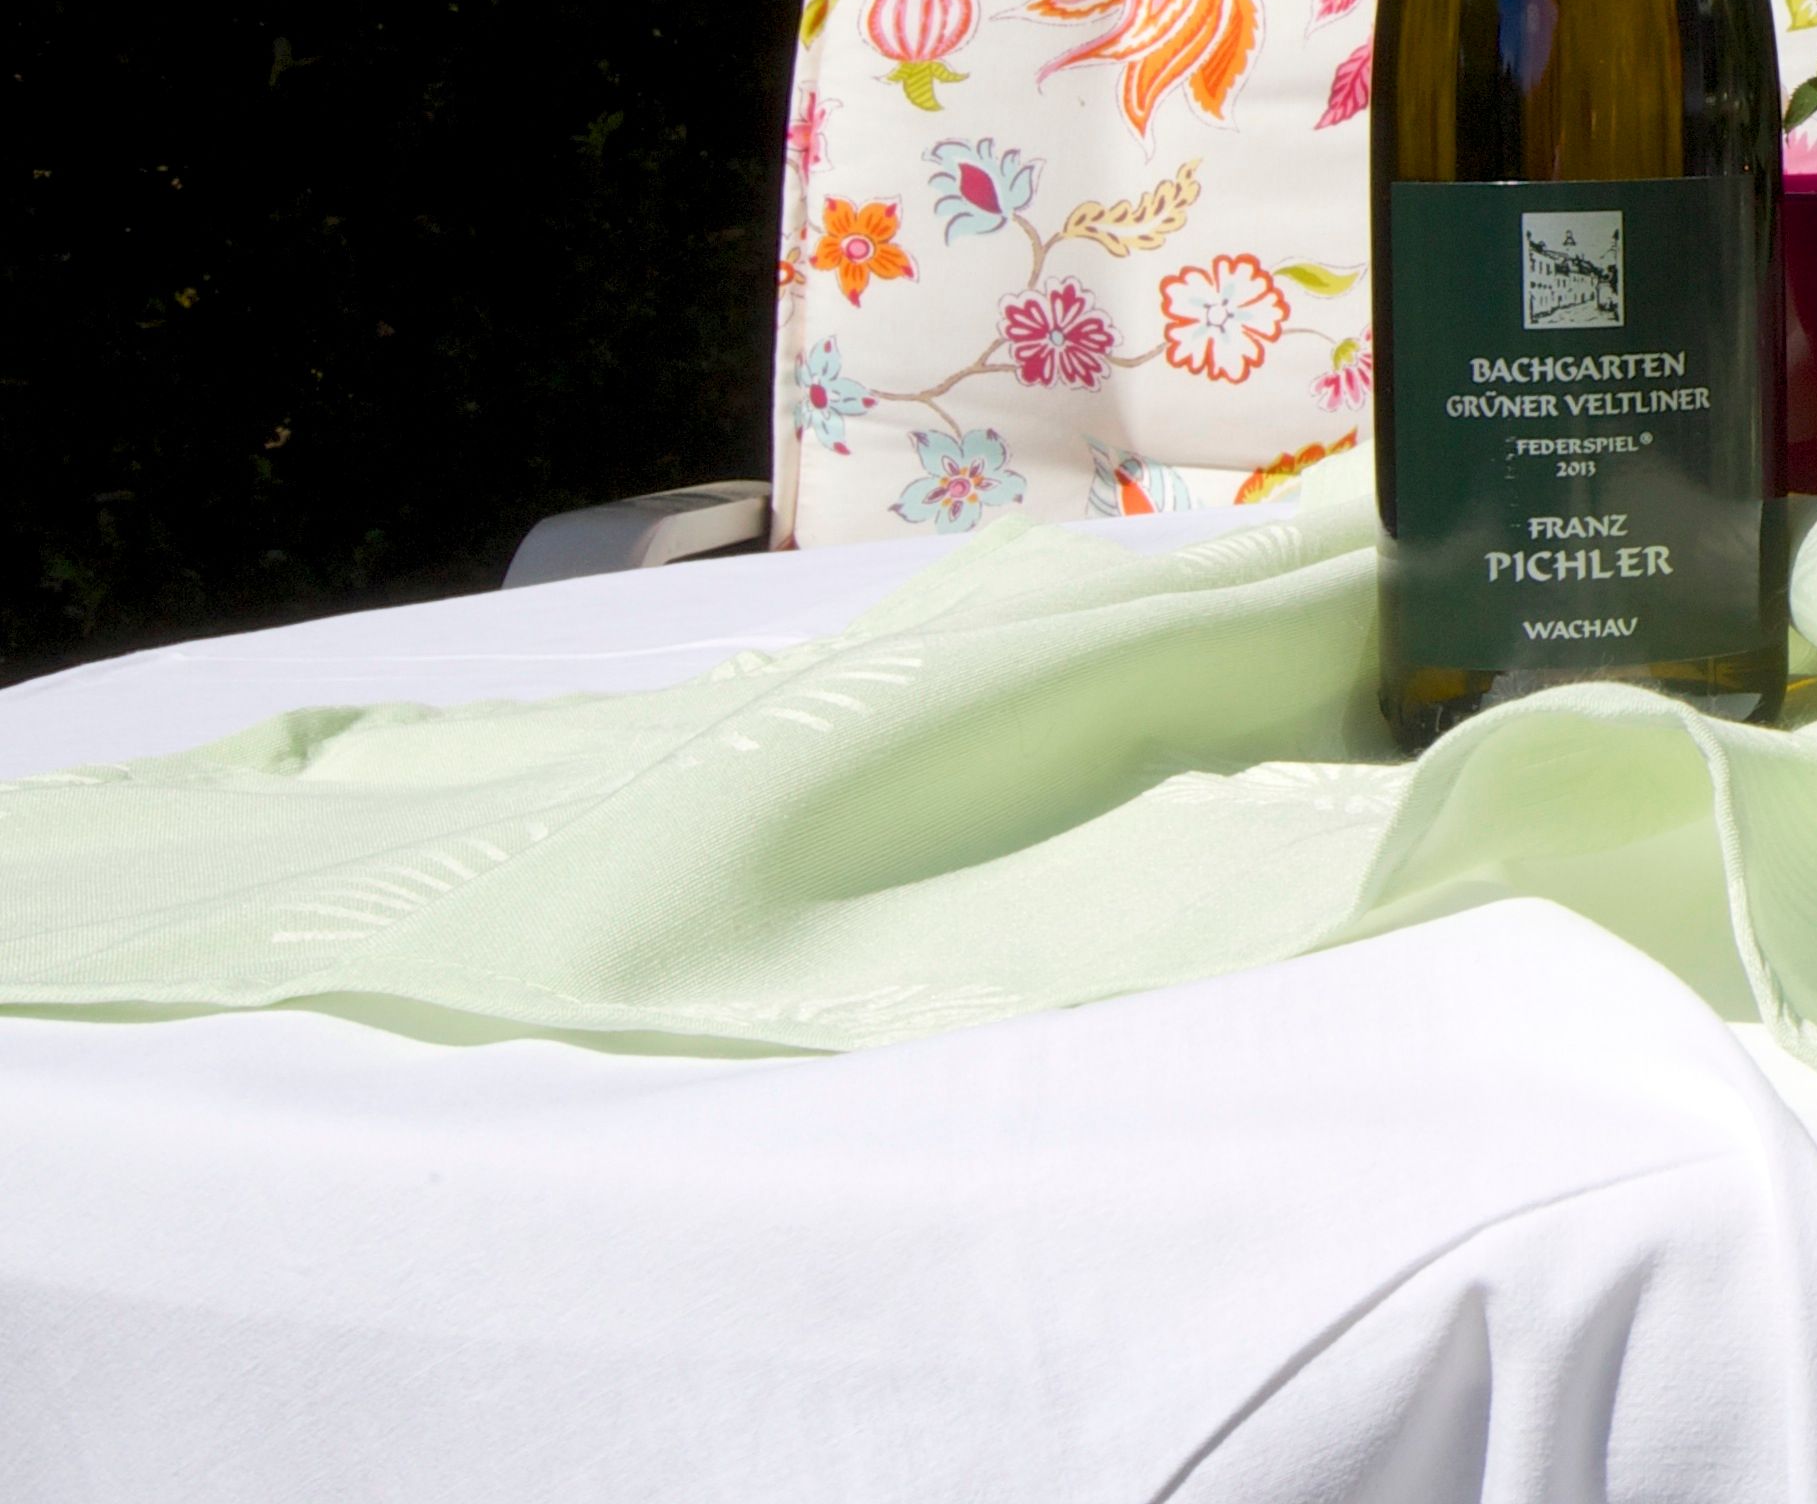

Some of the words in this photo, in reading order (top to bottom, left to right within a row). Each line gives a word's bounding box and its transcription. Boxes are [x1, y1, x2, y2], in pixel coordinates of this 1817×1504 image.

[1470, 351, 1686, 383] BACHGARTEN
[1446, 390, 1559, 418] GRÜNER
[1564, 387, 1711, 416] VELTLINER
[1556, 460, 1597, 477] 2013
[1527, 513, 1629, 540] FRANZ
[1484, 545, 1674, 582] PICHLER
[1522, 616, 1639, 640] WACHAU
